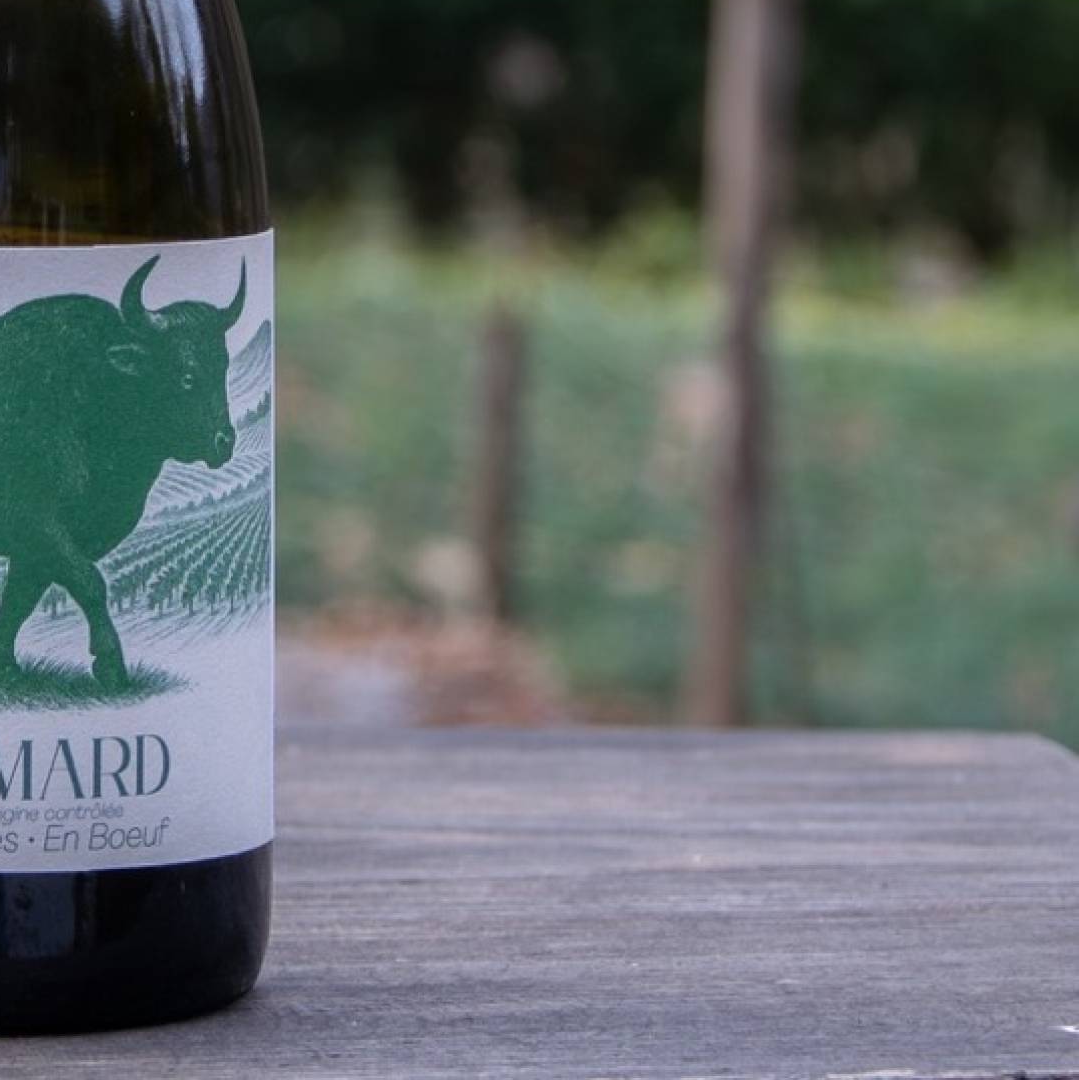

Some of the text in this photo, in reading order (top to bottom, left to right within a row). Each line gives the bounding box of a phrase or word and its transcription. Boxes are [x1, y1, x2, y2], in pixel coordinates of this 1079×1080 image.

[44, 801, 124, 821] contrôlée
[44, 824, 80, 852] En
[88, 816, 170, 851] Boeuf
